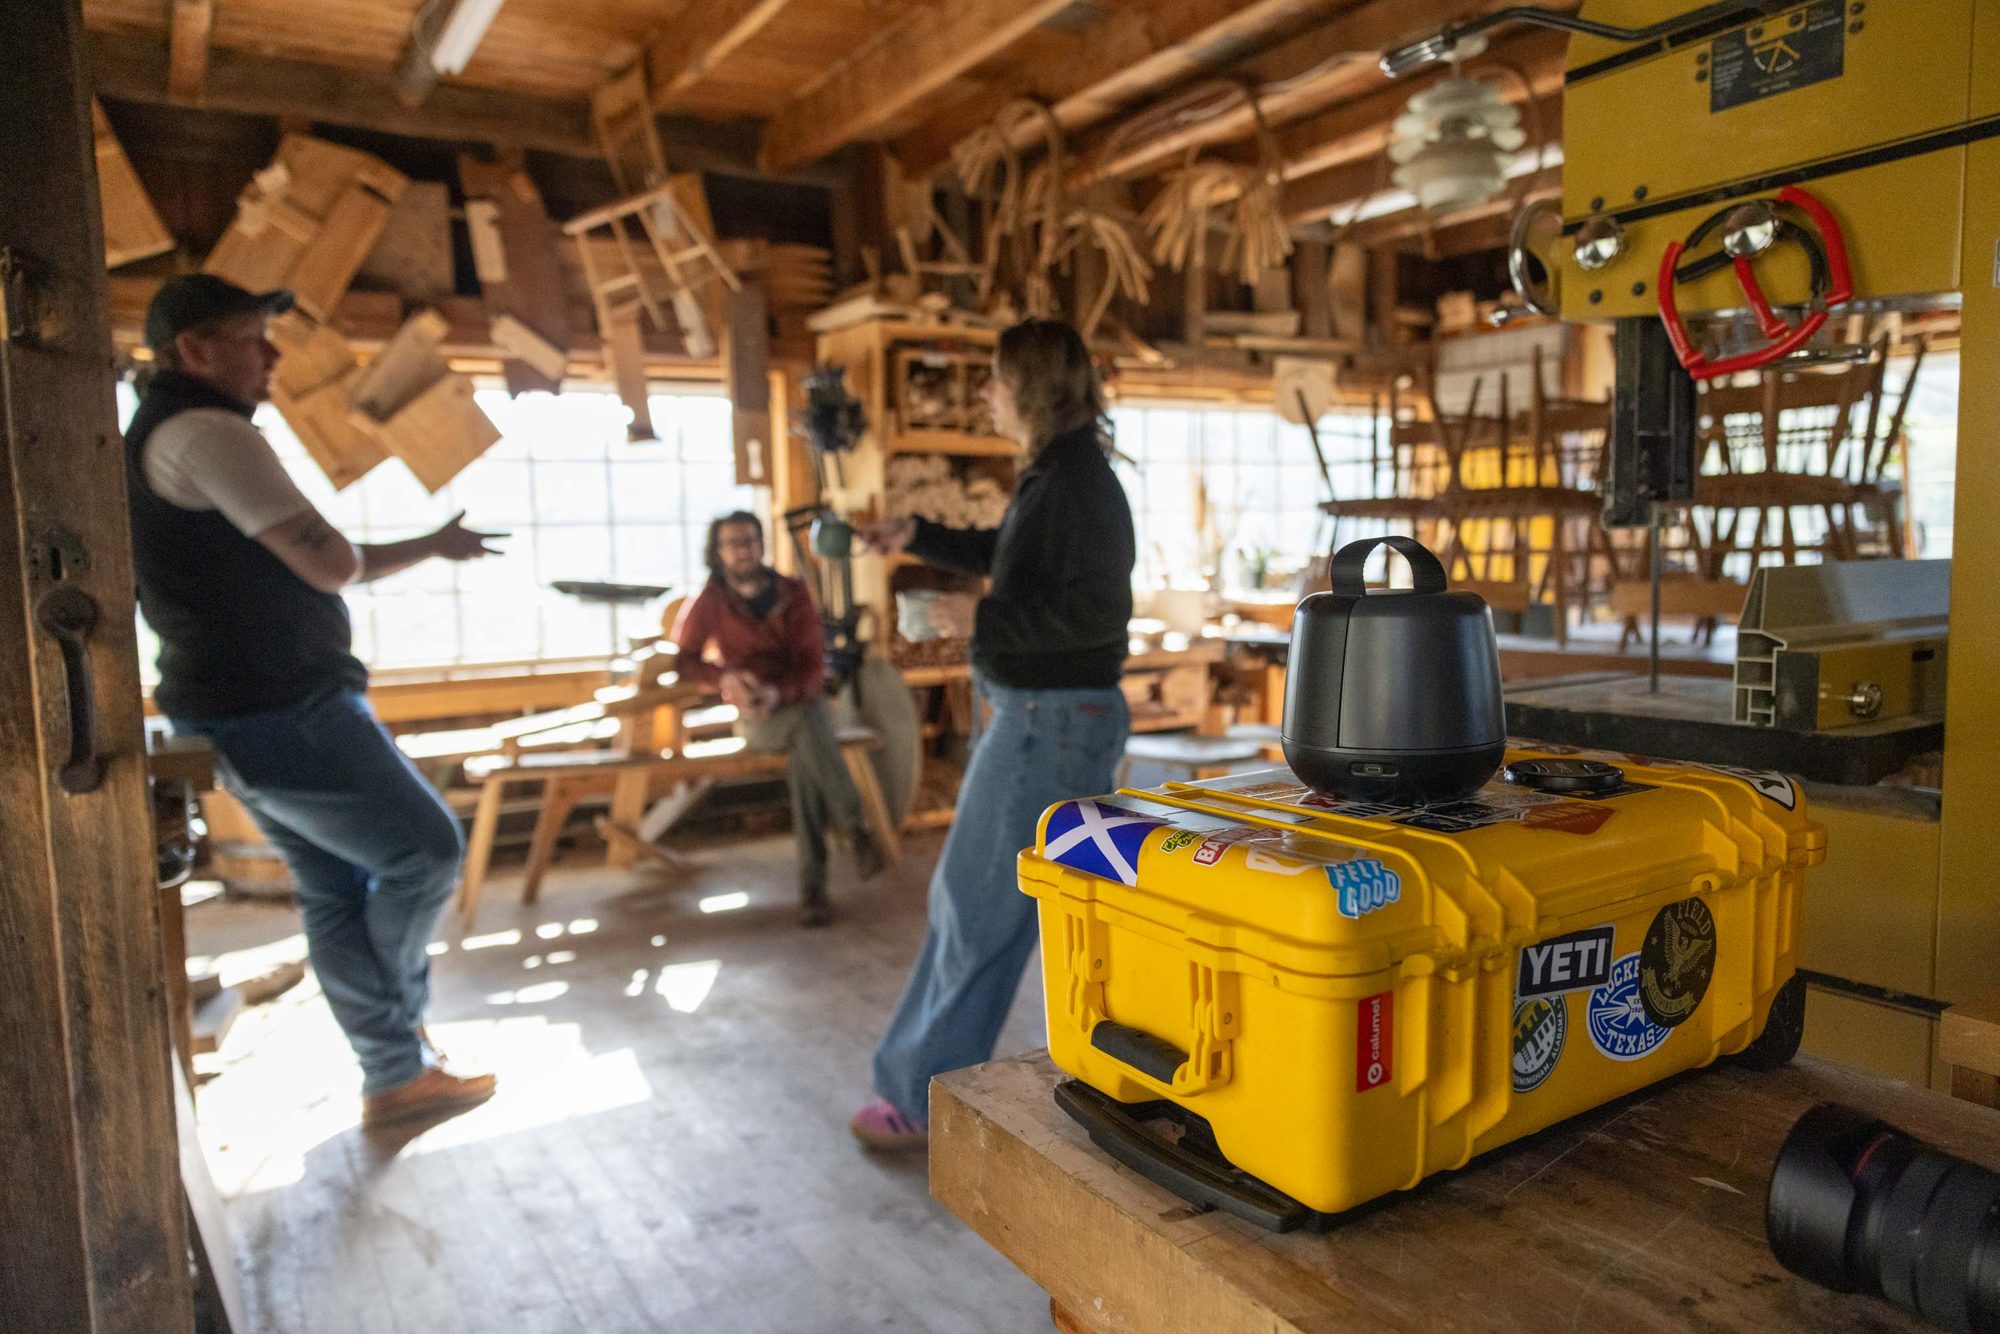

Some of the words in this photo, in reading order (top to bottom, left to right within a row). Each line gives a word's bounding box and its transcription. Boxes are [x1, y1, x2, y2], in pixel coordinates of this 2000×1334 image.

[1333, 860, 1380, 888] FELT
[1346, 872, 1398, 913] GOOD
[1678, 900, 1711, 935] FIELD
[1526, 938, 1606, 986] YETI
[1370, 998, 1381, 1060] calumet
[1551, 1010, 1564, 1060] ALABAMA
[1606, 1028, 1655, 1054] TEXAS
